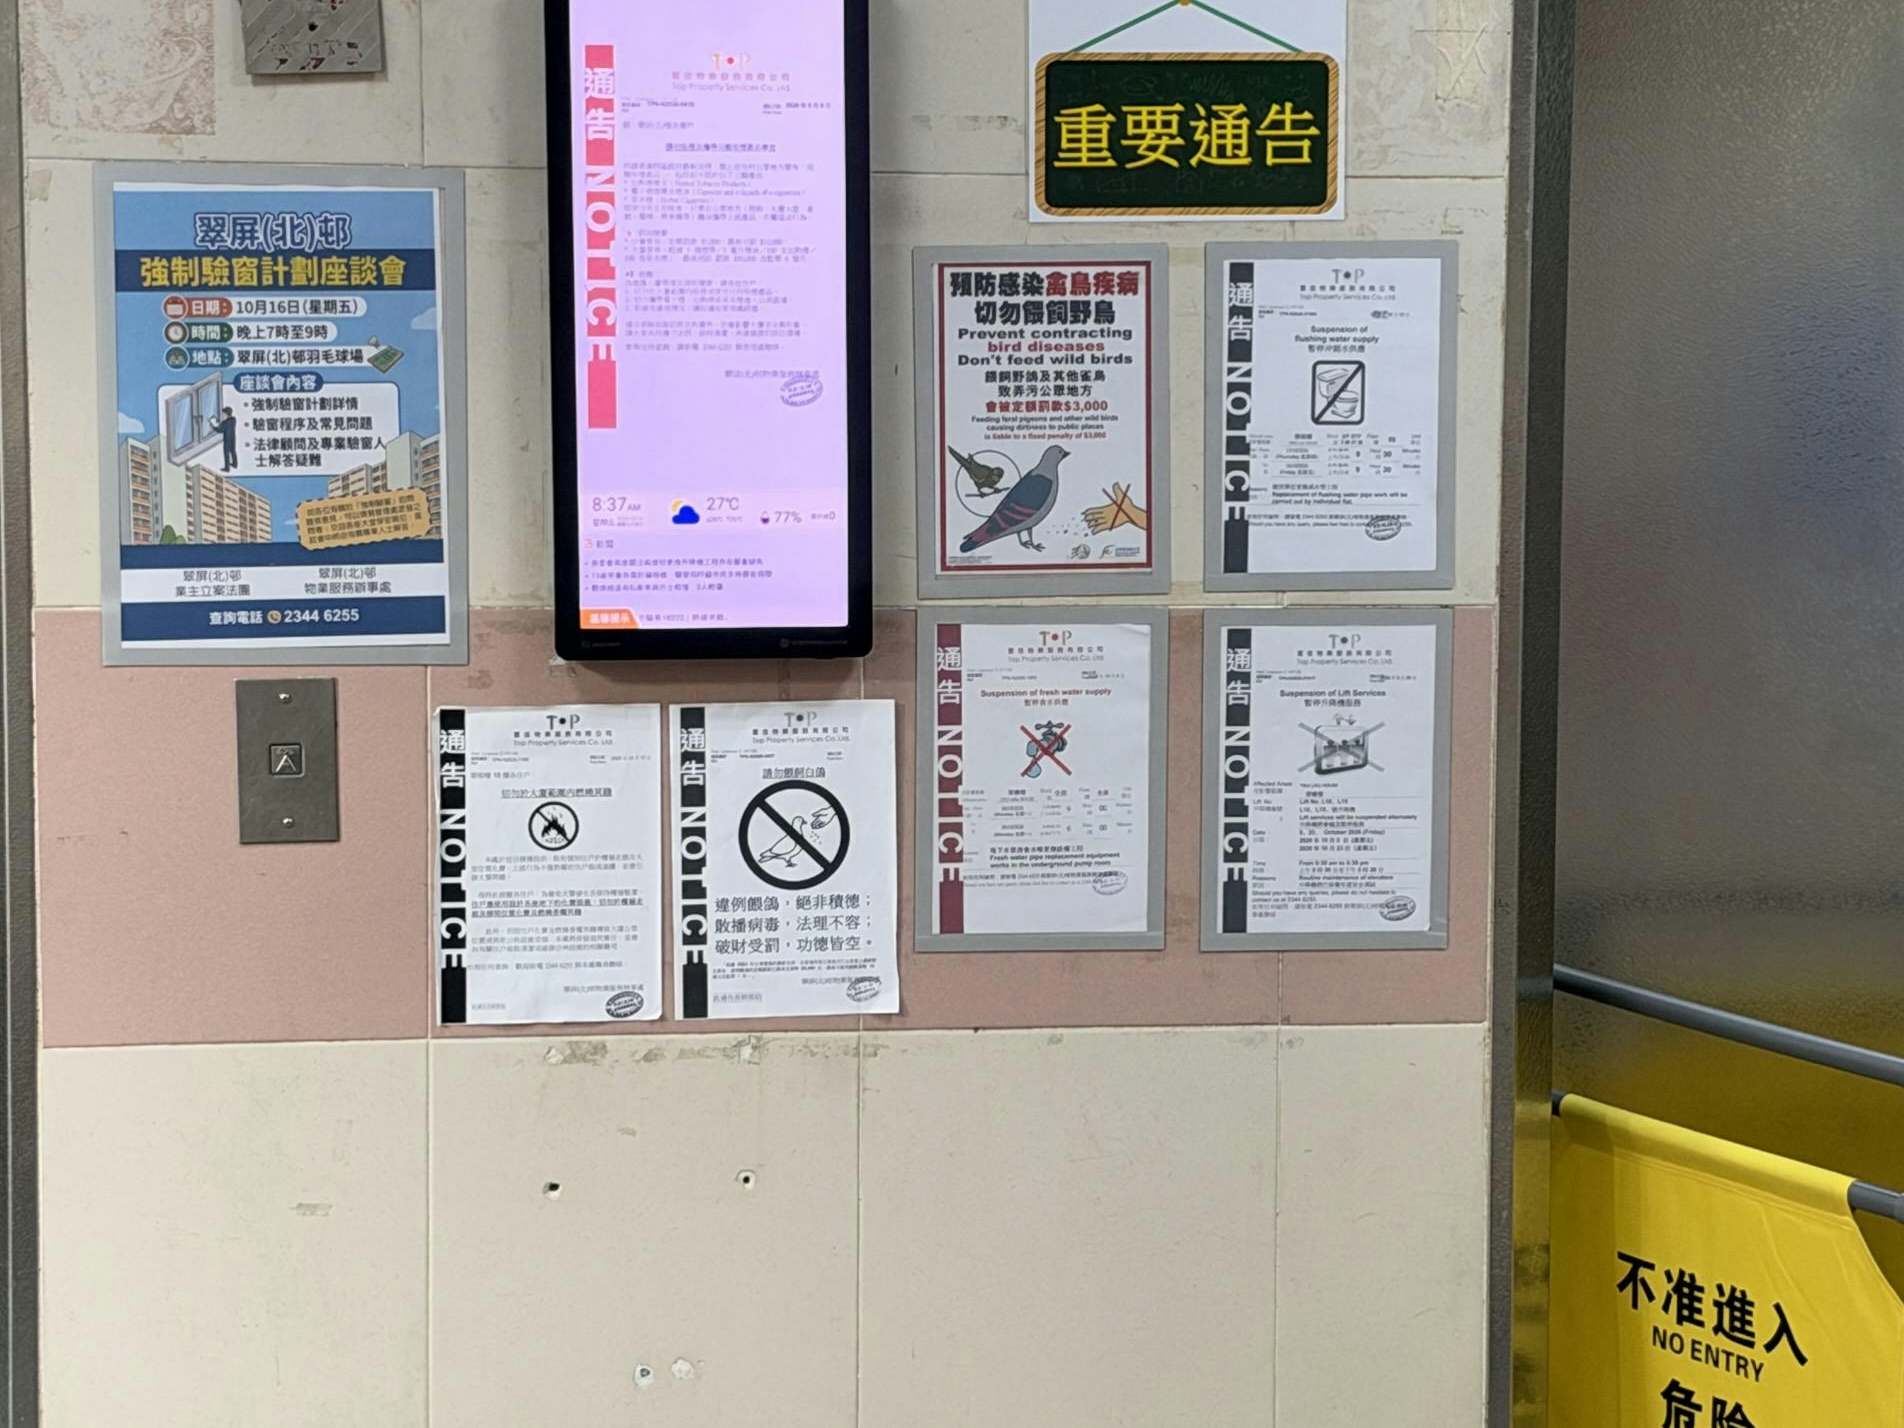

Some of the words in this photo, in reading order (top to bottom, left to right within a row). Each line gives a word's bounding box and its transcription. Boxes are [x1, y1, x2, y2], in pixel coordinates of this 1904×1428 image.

[585, 67, 615, 141] 通告
[1053, 101, 1321, 169] 重要通告
[196, 213, 350, 252] 翠屏(北)邨
[140, 255, 406, 287] 強制驗窗計劃座談會
[585, 165, 616, 363] NOTICE
[950, 271, 1139, 297] 預防感染禽鳥疾病
[975, 300, 1115, 325] 切勿餵飼野鳥
[236, 325, 328, 340] 晚上7時至9時
[958, 328, 1025, 339] Prevent
[1031, 327, 1133, 340] contracting
[988, 341, 1022, 353] bird
[1028, 341, 1105, 352] diseases
[958, 354, 1002, 365] Don't
[1007, 354, 1044, 365] feed
[1050, 354, 1085, 365] wild
[1091, 354, 1133, 364] birds
[239, 375, 317, 391] 座談會內容
[252, 397, 358, 411] 強制驗窗計劃詳情
[252, 417, 373, 431] 驗窗程序及常見問題
[592, 497, 627, 512] 8:37
[774, 511, 802, 523] 77%
[209, 611, 263, 626] 查詢電話
[284, 609, 319, 623] 2344
[324, 608, 360, 622] 6255
[937, 647, 962, 705] 通告
[1280, 690, 1325, 698] Suspension
[439, 728, 465, 788] 通告
[680, 727, 706, 787] 通告
[938, 725, 964, 882] NOTICE
[439, 808, 468, 970] NOTICE
[680, 806, 708, 964] NOTICE
[1616, 1250, 1810, 1368] 不准進入
[1651, 1324, 1685, 1357] NO
[1689, 1337, 1765, 1384] ENTRY
